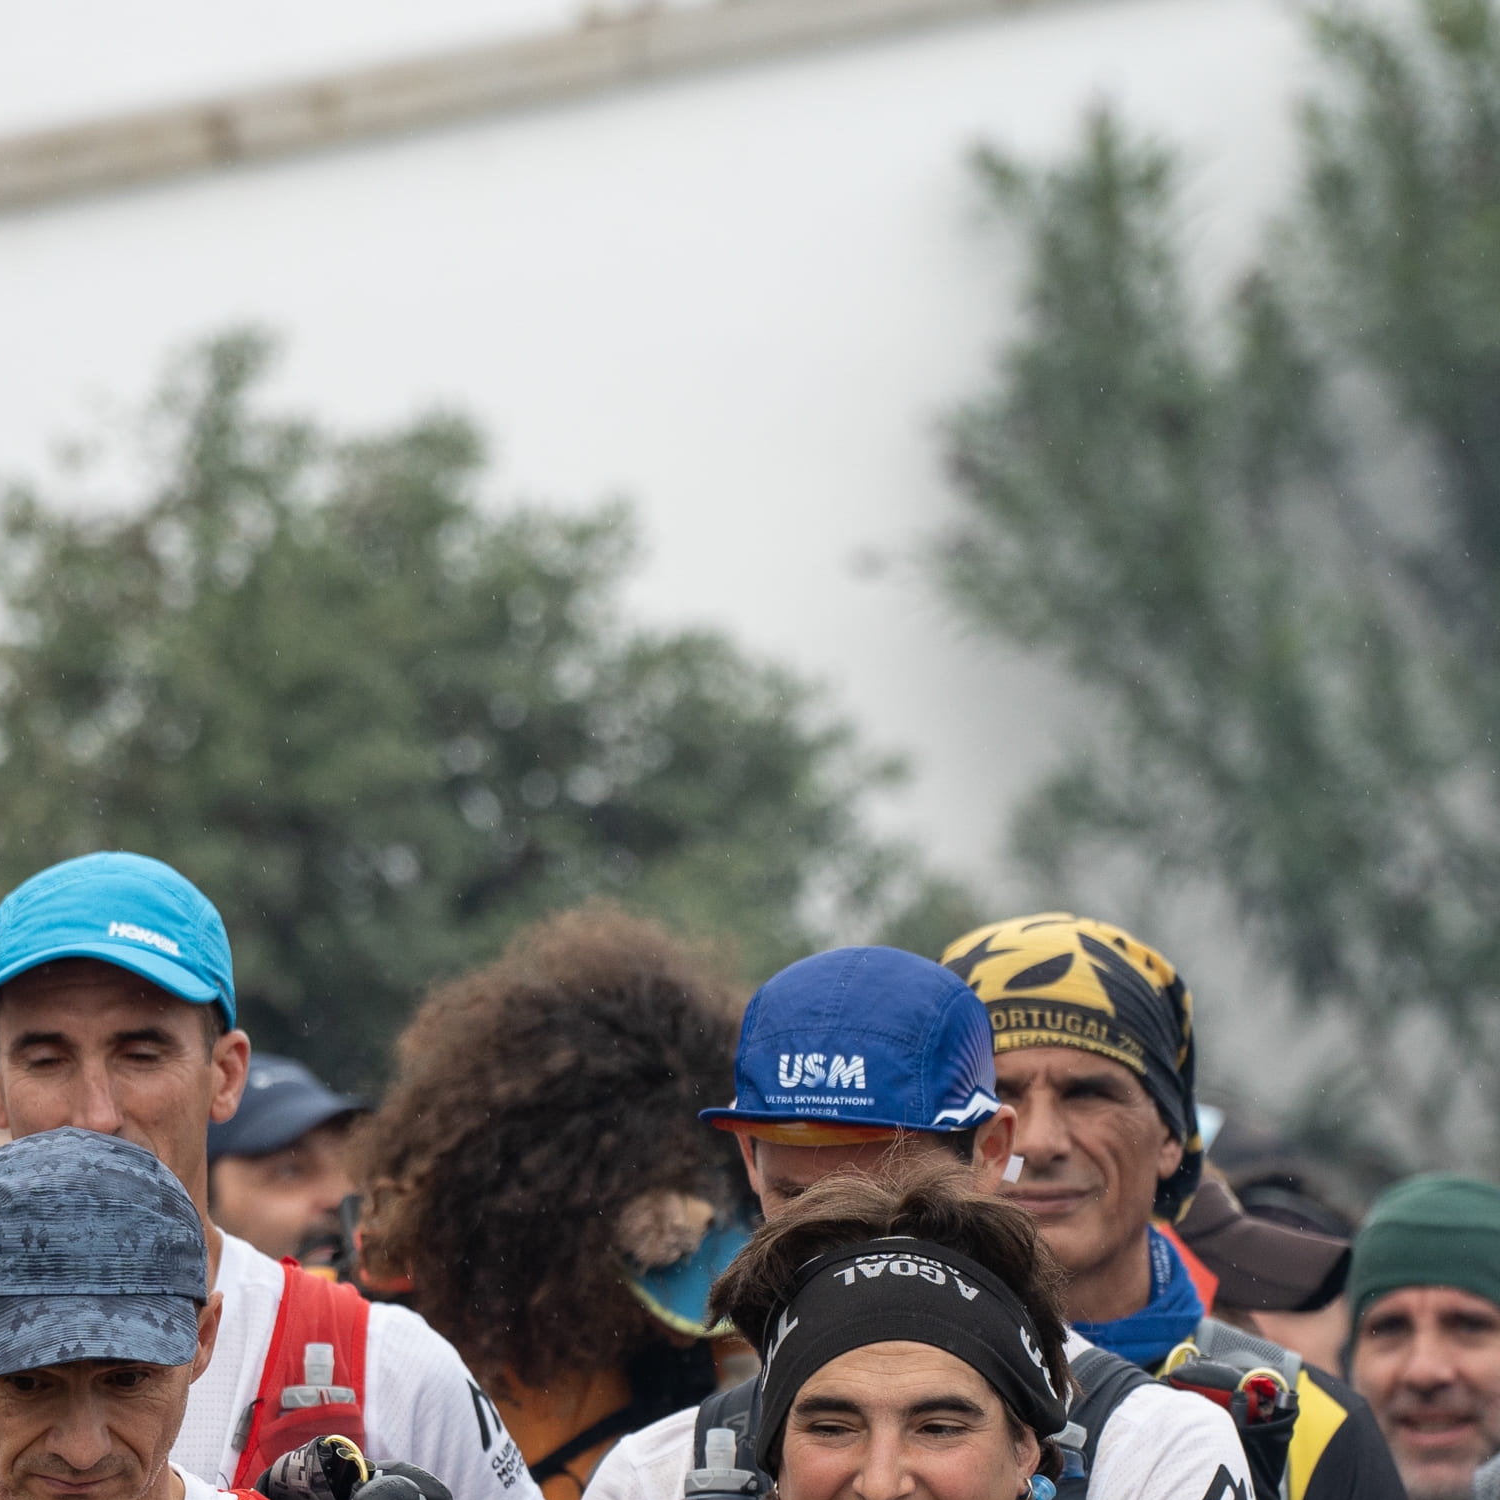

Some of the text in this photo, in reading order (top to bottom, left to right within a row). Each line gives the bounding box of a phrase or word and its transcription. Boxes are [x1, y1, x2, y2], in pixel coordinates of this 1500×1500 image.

[988, 1006, 1110, 1042] ORTUGAL
[778, 1052, 867, 1089] USM
[765, 1095, 793, 1105] ULTRA
[795, 1107, 839, 1117] MADEIRA
[833, 1259, 947, 1286] GOAL
